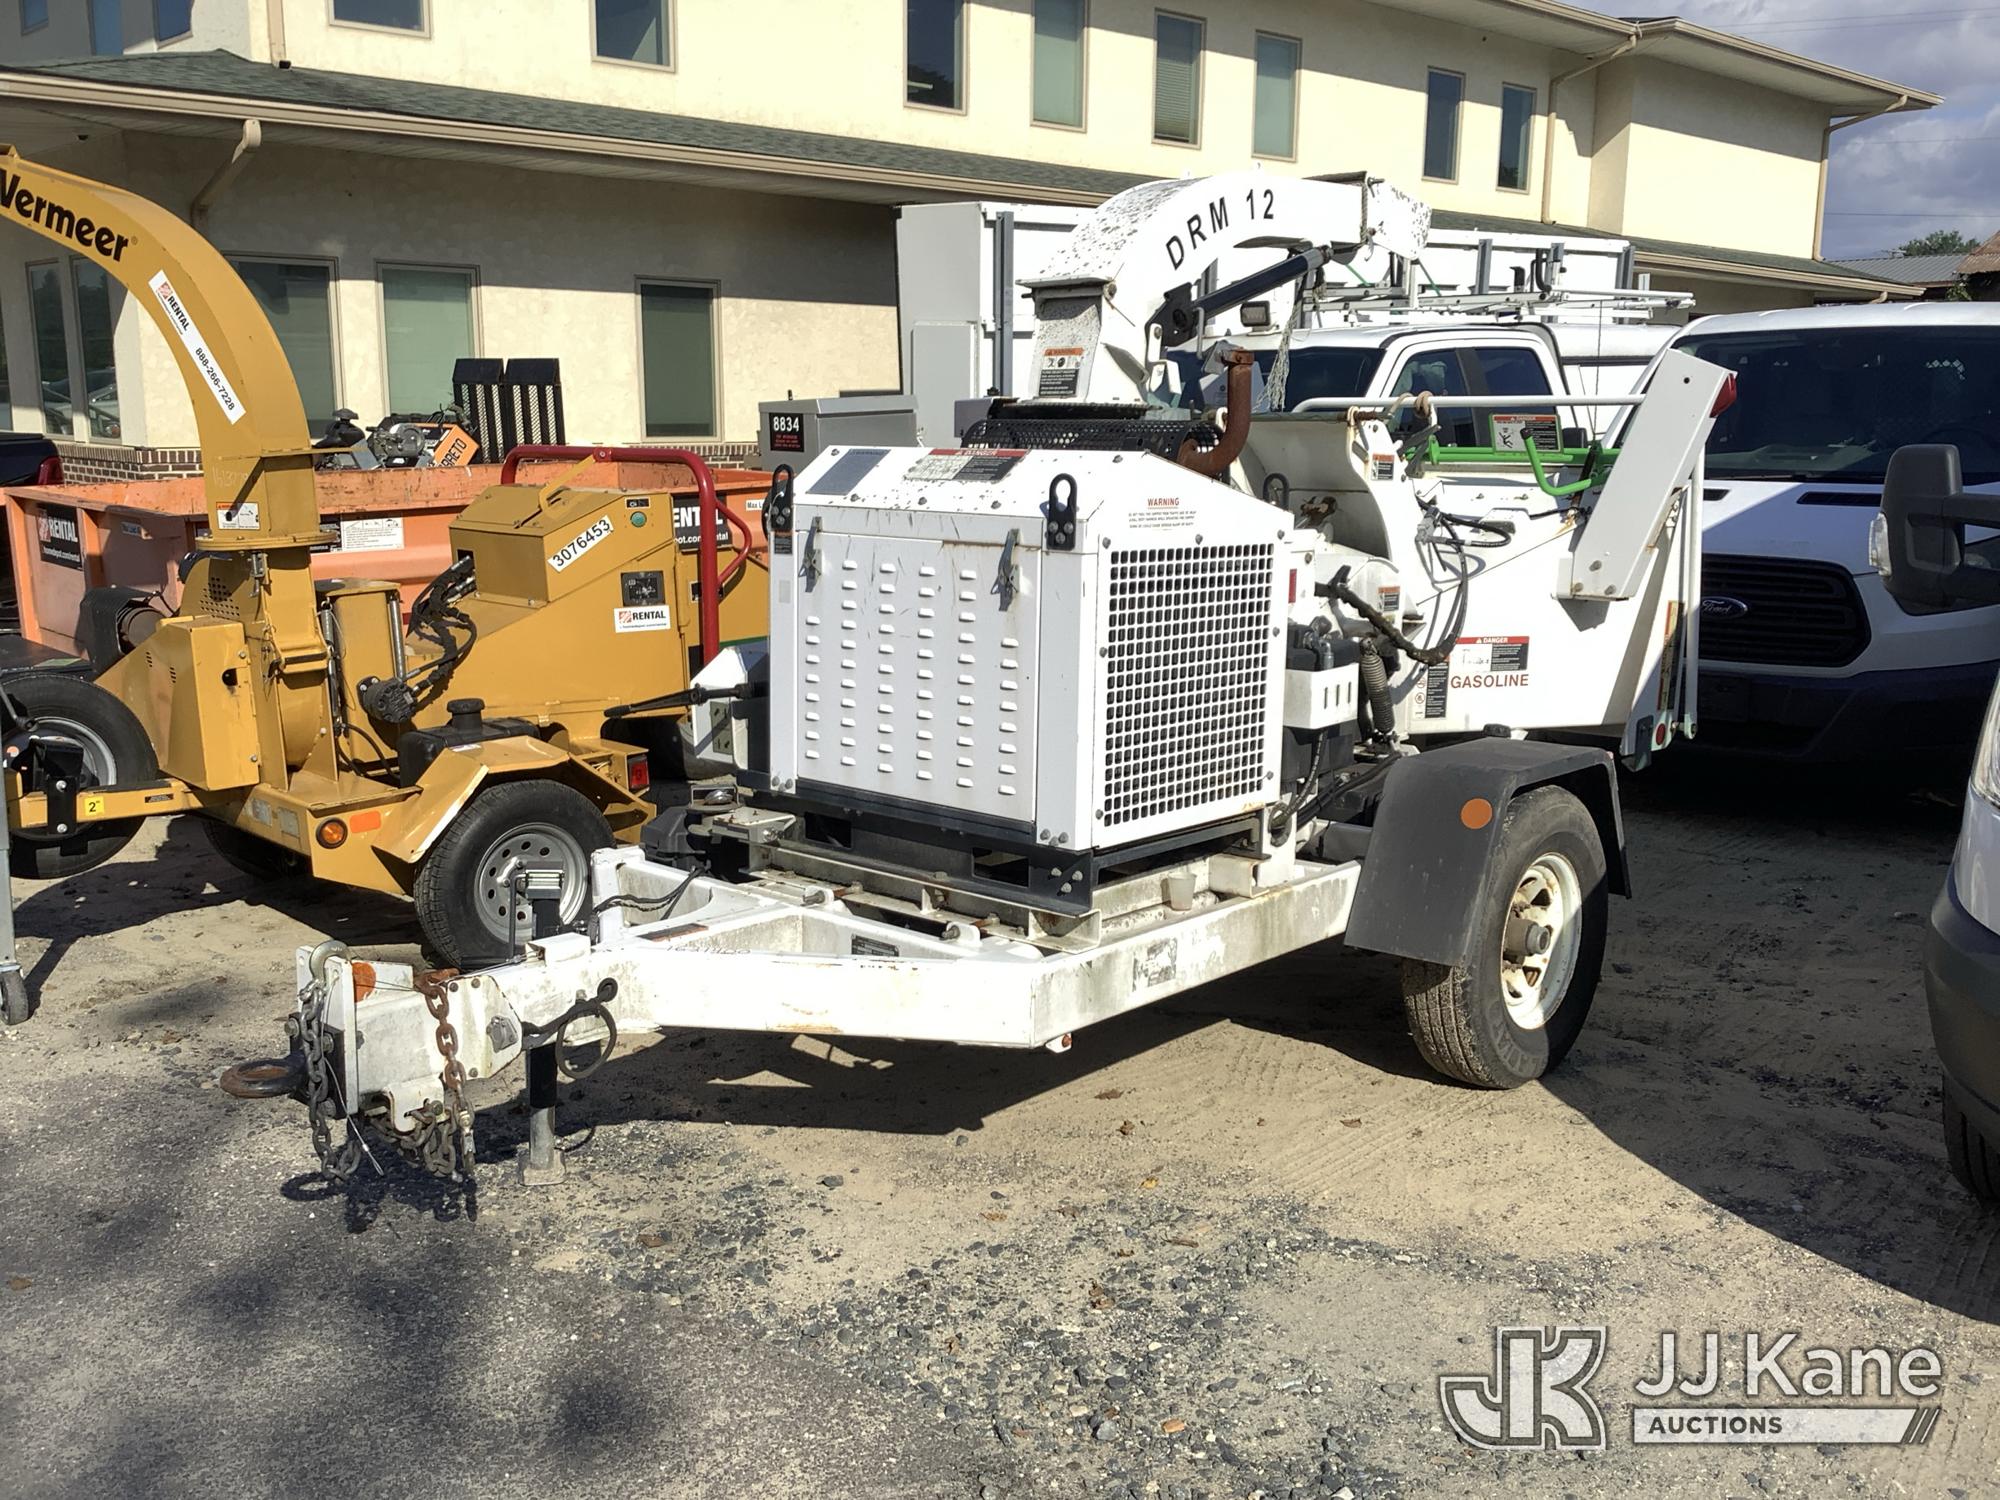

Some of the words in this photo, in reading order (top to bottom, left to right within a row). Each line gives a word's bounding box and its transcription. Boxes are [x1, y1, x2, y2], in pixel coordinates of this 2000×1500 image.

[0, 167, 129, 262] Vermeer
[1165, 196, 1229, 271] DRM
[1246, 188, 1275, 220] 12
[167, 295, 190, 331] RENTAL
[195, 347, 236, 411] 888-266-7228
[773, 416, 800, 432] 8834
[1147, 497, 1180, 506] WARNING
[48, 516, 79, 542] RENTAL
[552, 519, 611, 567] 3076453
[632, 610, 667, 621] RENTAL
[1450, 674, 1529, 689] GASOLINE
